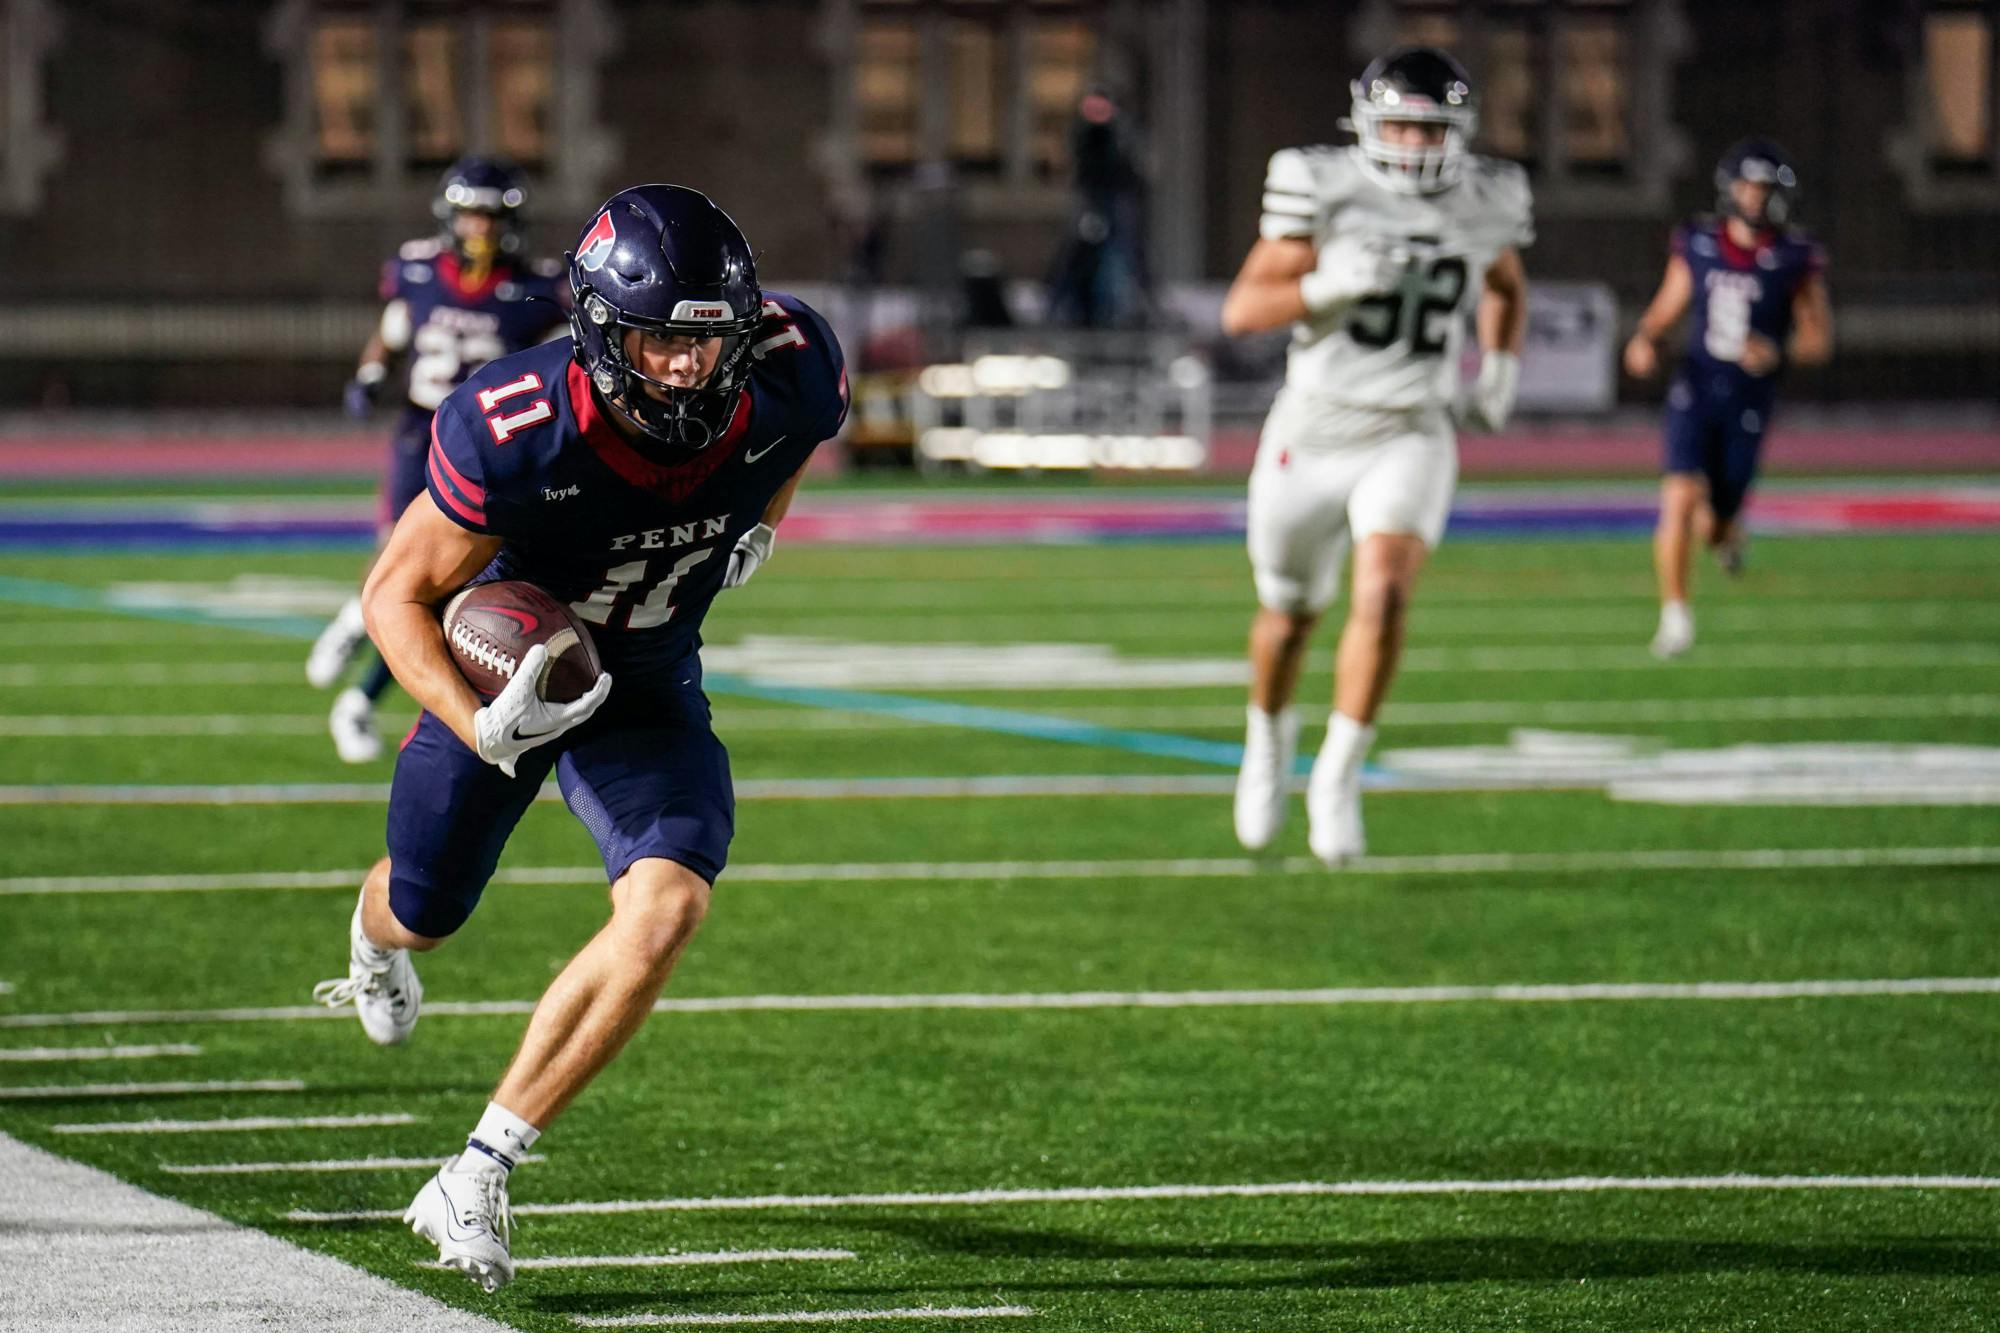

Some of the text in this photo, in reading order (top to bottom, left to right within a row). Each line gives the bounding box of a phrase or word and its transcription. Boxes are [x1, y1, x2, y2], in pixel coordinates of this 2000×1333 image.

[692, 308, 722, 318] PENN
[476, 370, 556, 446] 11
[543, 488, 568, 502] Ivy
[609, 513, 731, 550] PENN
[569, 547, 714, 629] 11
